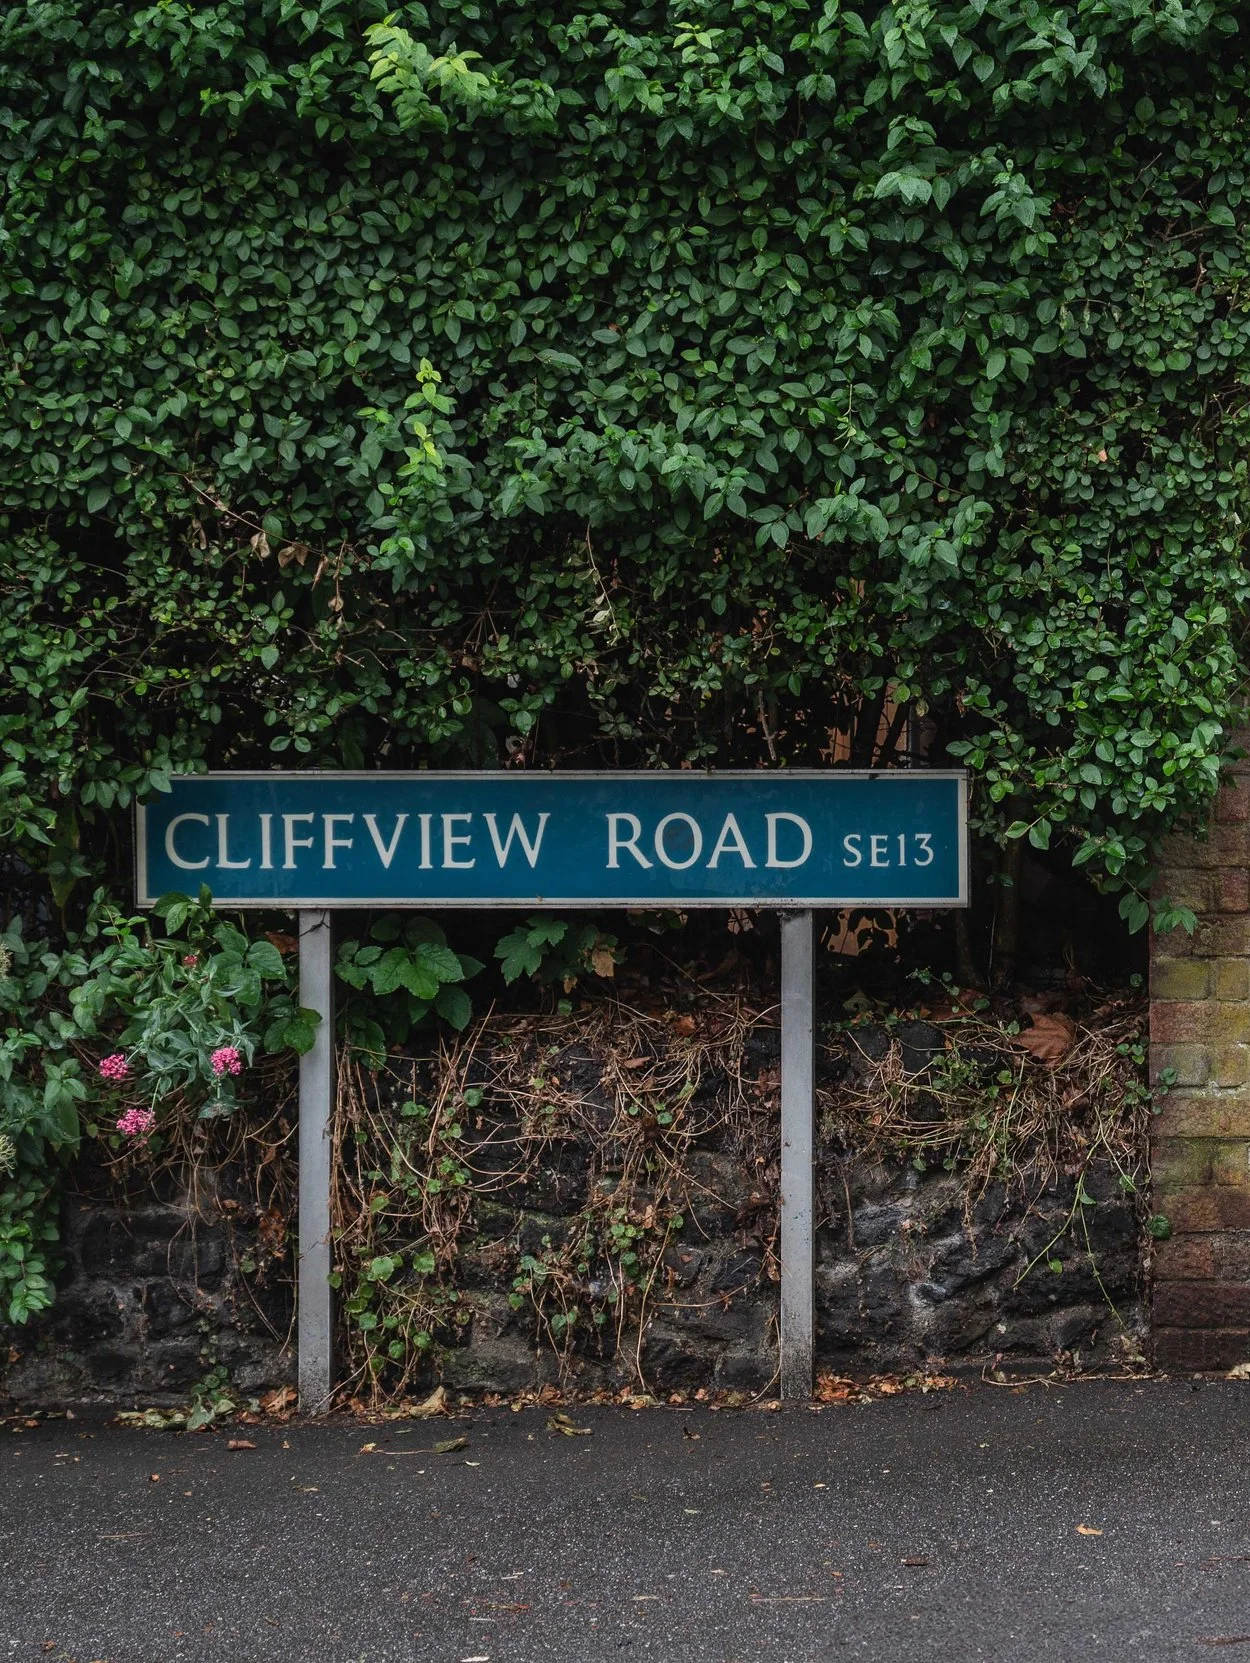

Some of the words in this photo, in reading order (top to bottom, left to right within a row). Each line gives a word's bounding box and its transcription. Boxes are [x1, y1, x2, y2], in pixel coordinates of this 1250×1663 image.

[164, 812, 551, 870] CLIFFVIEW
[606, 812, 813, 870] ROAD
[843, 833, 934, 868] SE13
